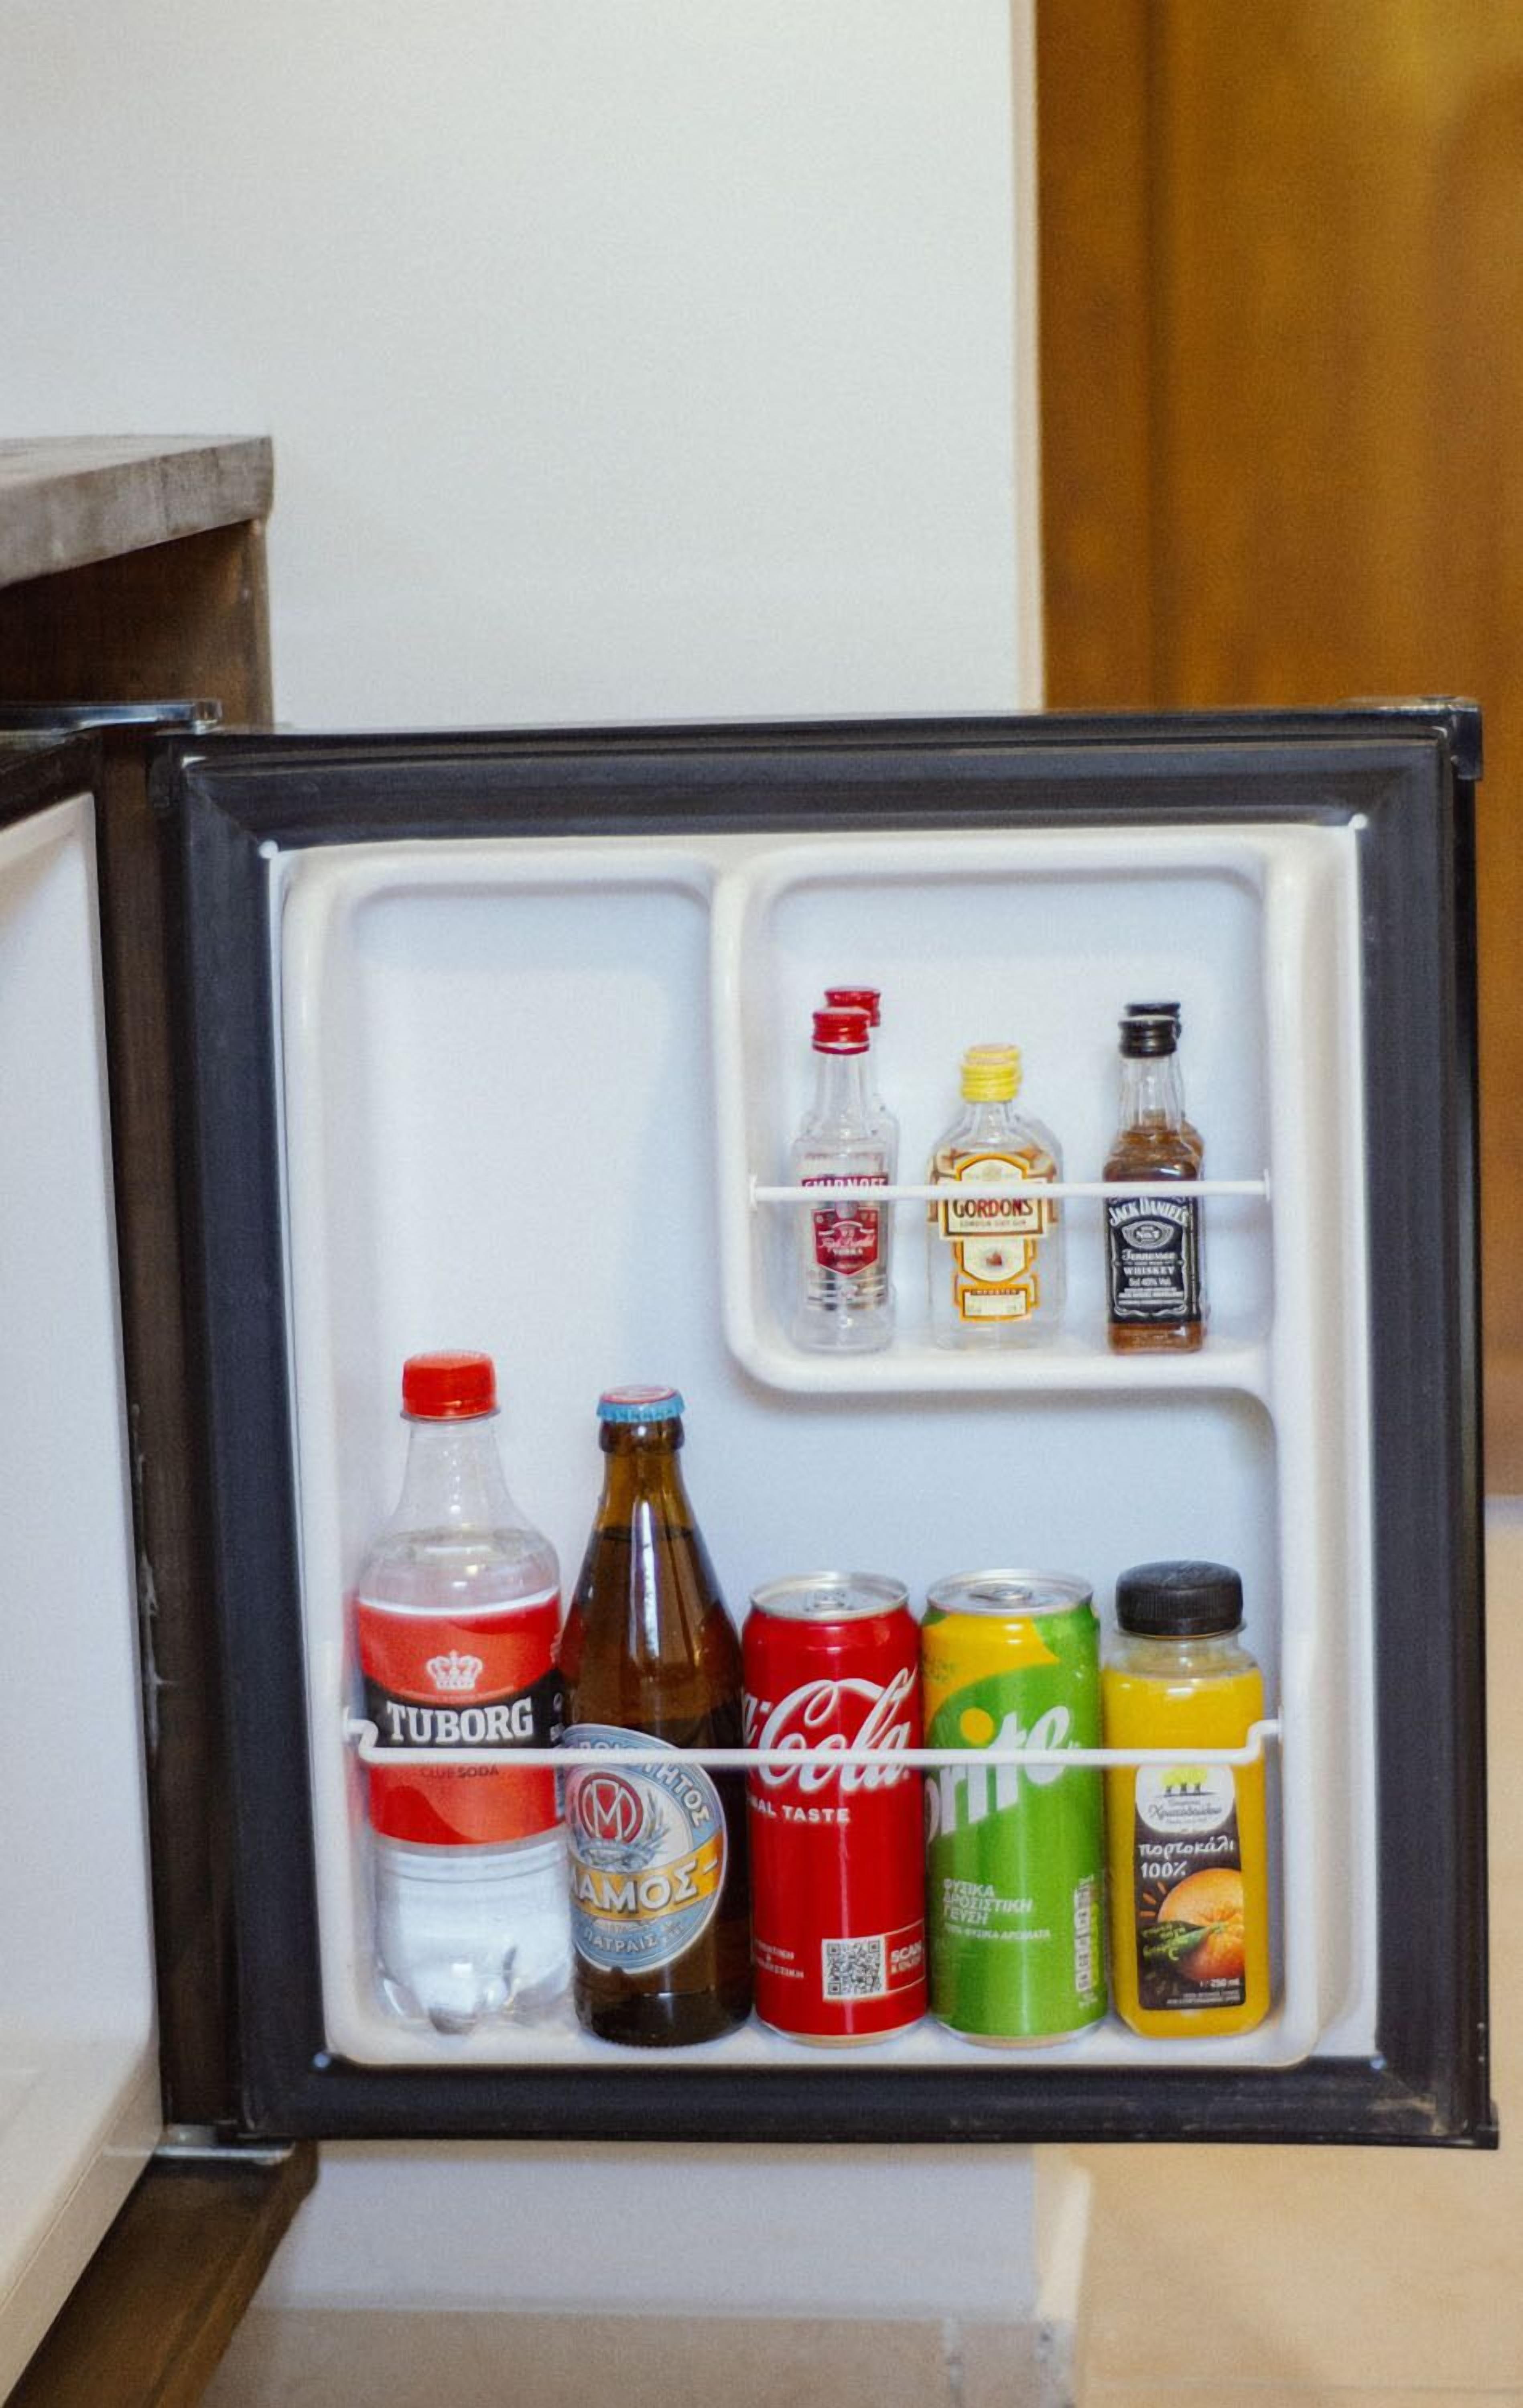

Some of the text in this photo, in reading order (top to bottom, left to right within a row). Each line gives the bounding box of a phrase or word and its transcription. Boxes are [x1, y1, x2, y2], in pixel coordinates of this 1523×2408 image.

[1109, 1202, 1140, 1227] JACK
[1123, 1266, 1175, 1275] WHISKEY
[386, 1696, 534, 1743] TUBORG
[782, 1805, 851, 1823] TASTE
[1141, 1860, 1187, 1879] 100%
[575, 1858, 697, 1911] ΑΜΟΣ
[944, 1891, 1033, 1914] ΔΡΟΣΙΣΤΙΚΗ
[944, 1906, 988, 1925] ΓΕΥΣΗ
